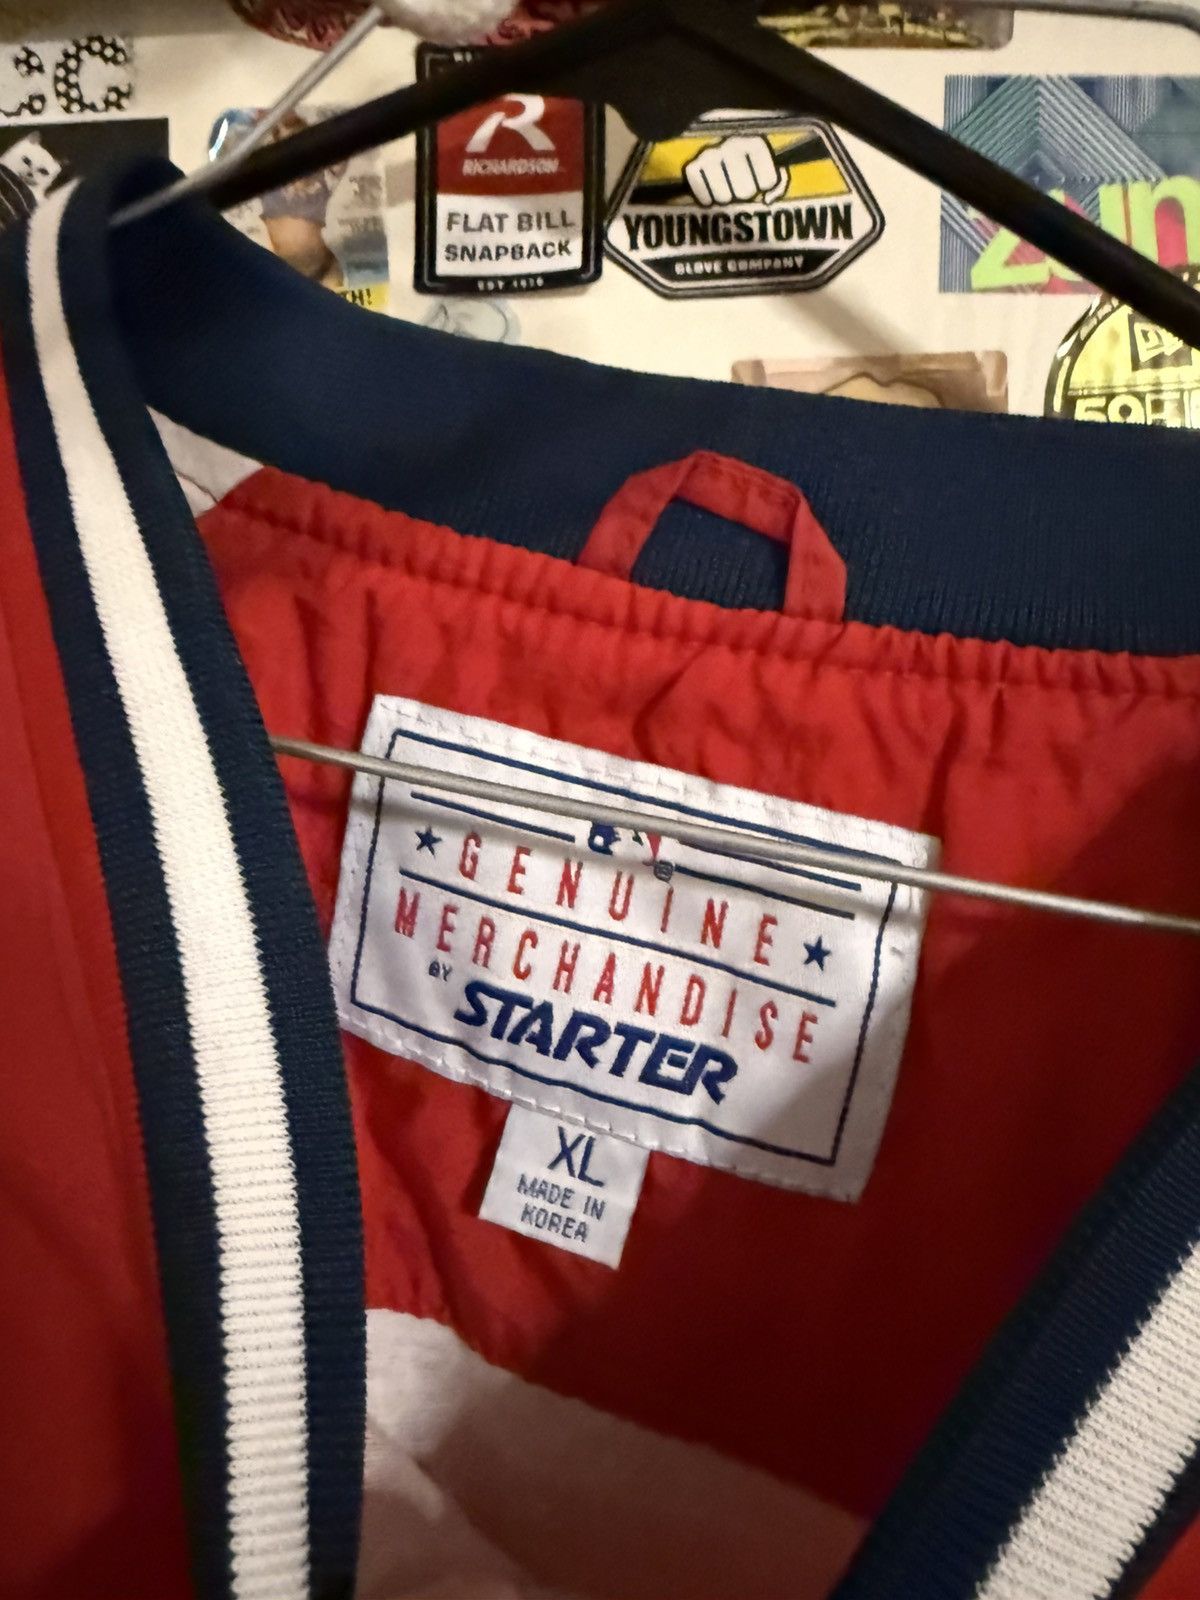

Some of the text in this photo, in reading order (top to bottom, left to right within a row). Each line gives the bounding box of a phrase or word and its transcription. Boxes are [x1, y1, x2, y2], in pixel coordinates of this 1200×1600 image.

[462, 157, 560, 177] RICHARDSON
[446, 209, 575, 234] FLAT BILL
[622, 202, 854, 250] YOUNGSTOWN
[444, 239, 572, 262] SNAPBACK
[674, 255, 804, 275] GLOVE COMPANY
[457, 832, 779, 967] GENUINE
[394, 890, 820, 1065] MERCHANDISE
[428, 960, 452, 982] BY
[454, 980, 738, 1105] STARTER
[547, 1126, 605, 1188] XL
[517, 1173, 606, 1221] MADE IN
[521, 1203, 590, 1243] KOREA
